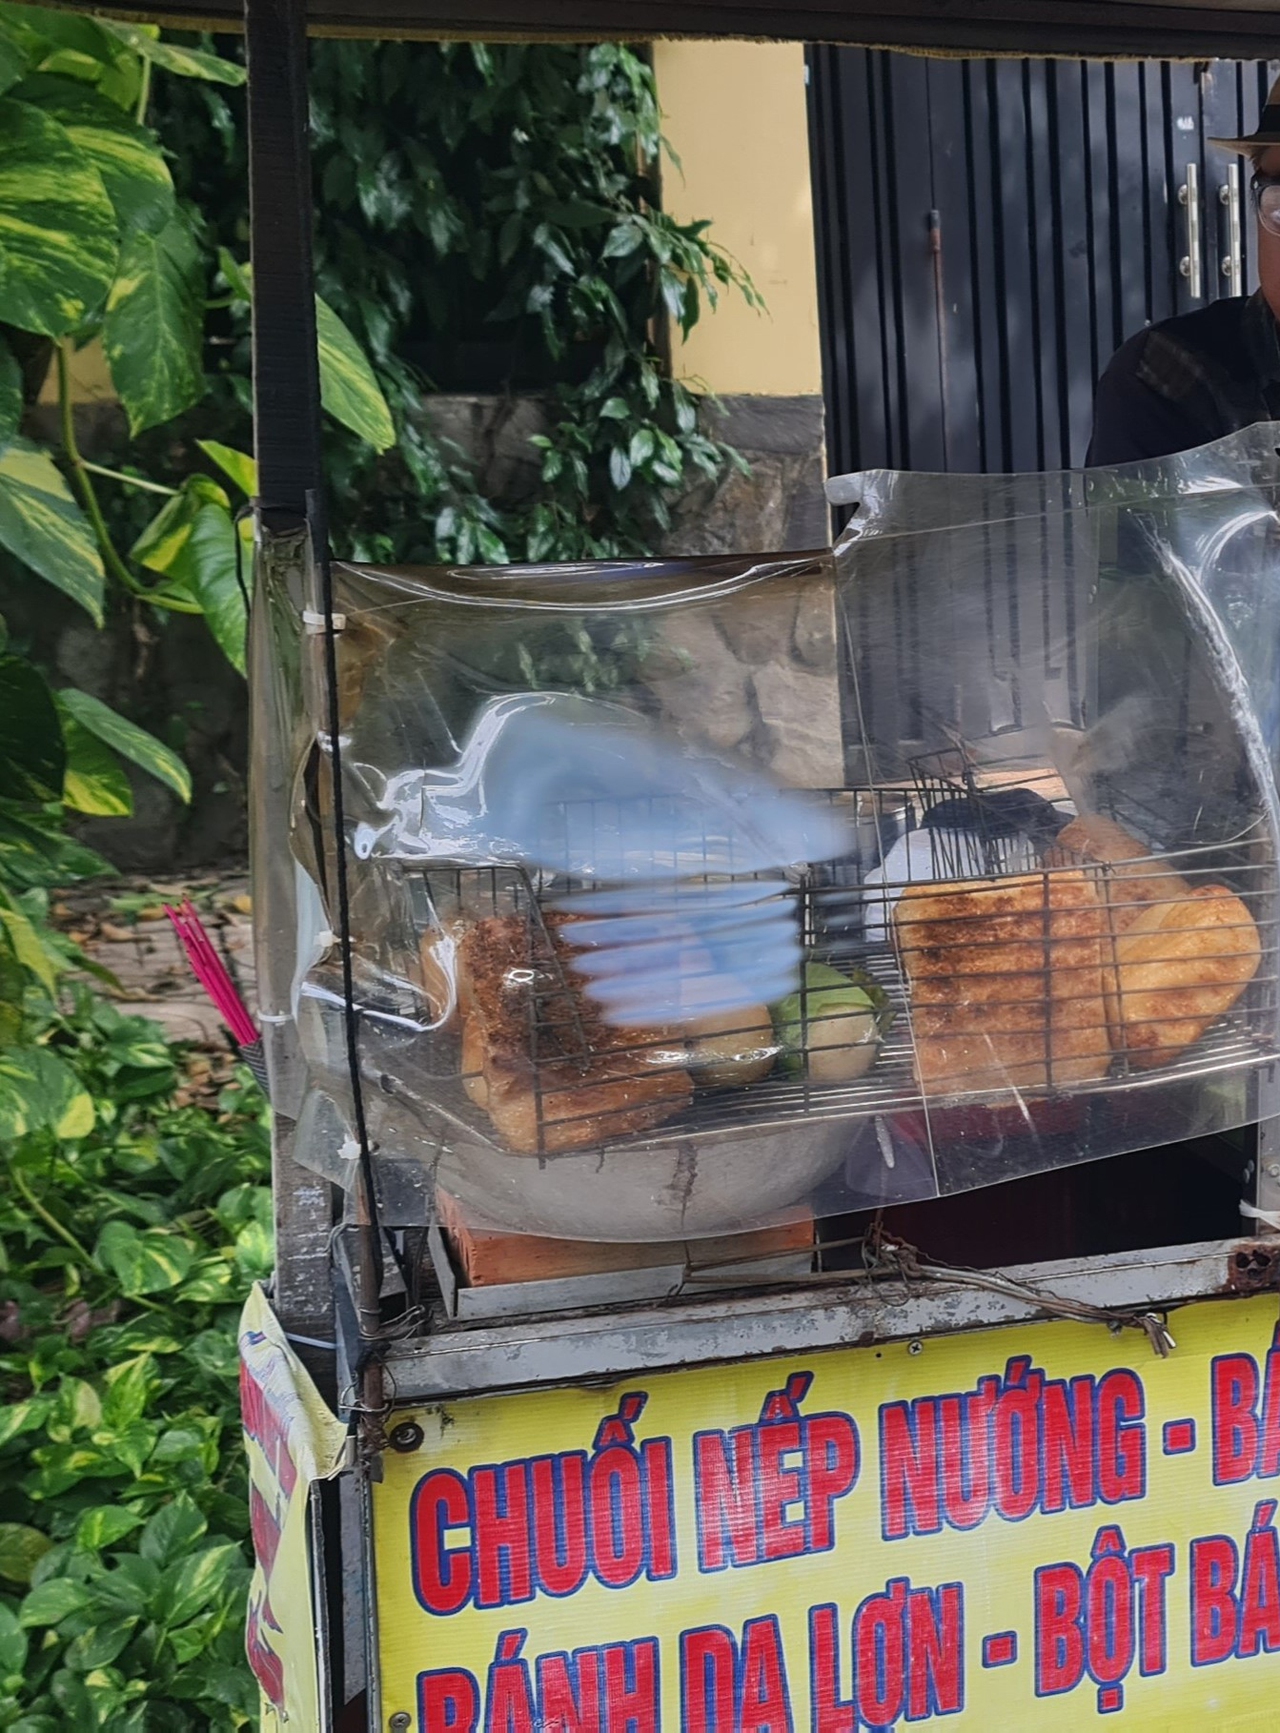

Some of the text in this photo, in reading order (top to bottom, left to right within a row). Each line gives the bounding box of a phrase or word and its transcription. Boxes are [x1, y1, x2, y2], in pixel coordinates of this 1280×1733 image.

[410, 1391, 677, 1616] CHUỐI
[693, 1370, 860, 1574] NẾP
[878, 1355, 1146, 1541] NƯỚNG
[1163, 1418, 1195, 1455] -
[680, 1614, 794, 1733] DA
[809, 1577, 963, 1733] LỢN
[982, 1630, 1017, 1668] -
[1034, 1524, 1175, 1713] BỘT
